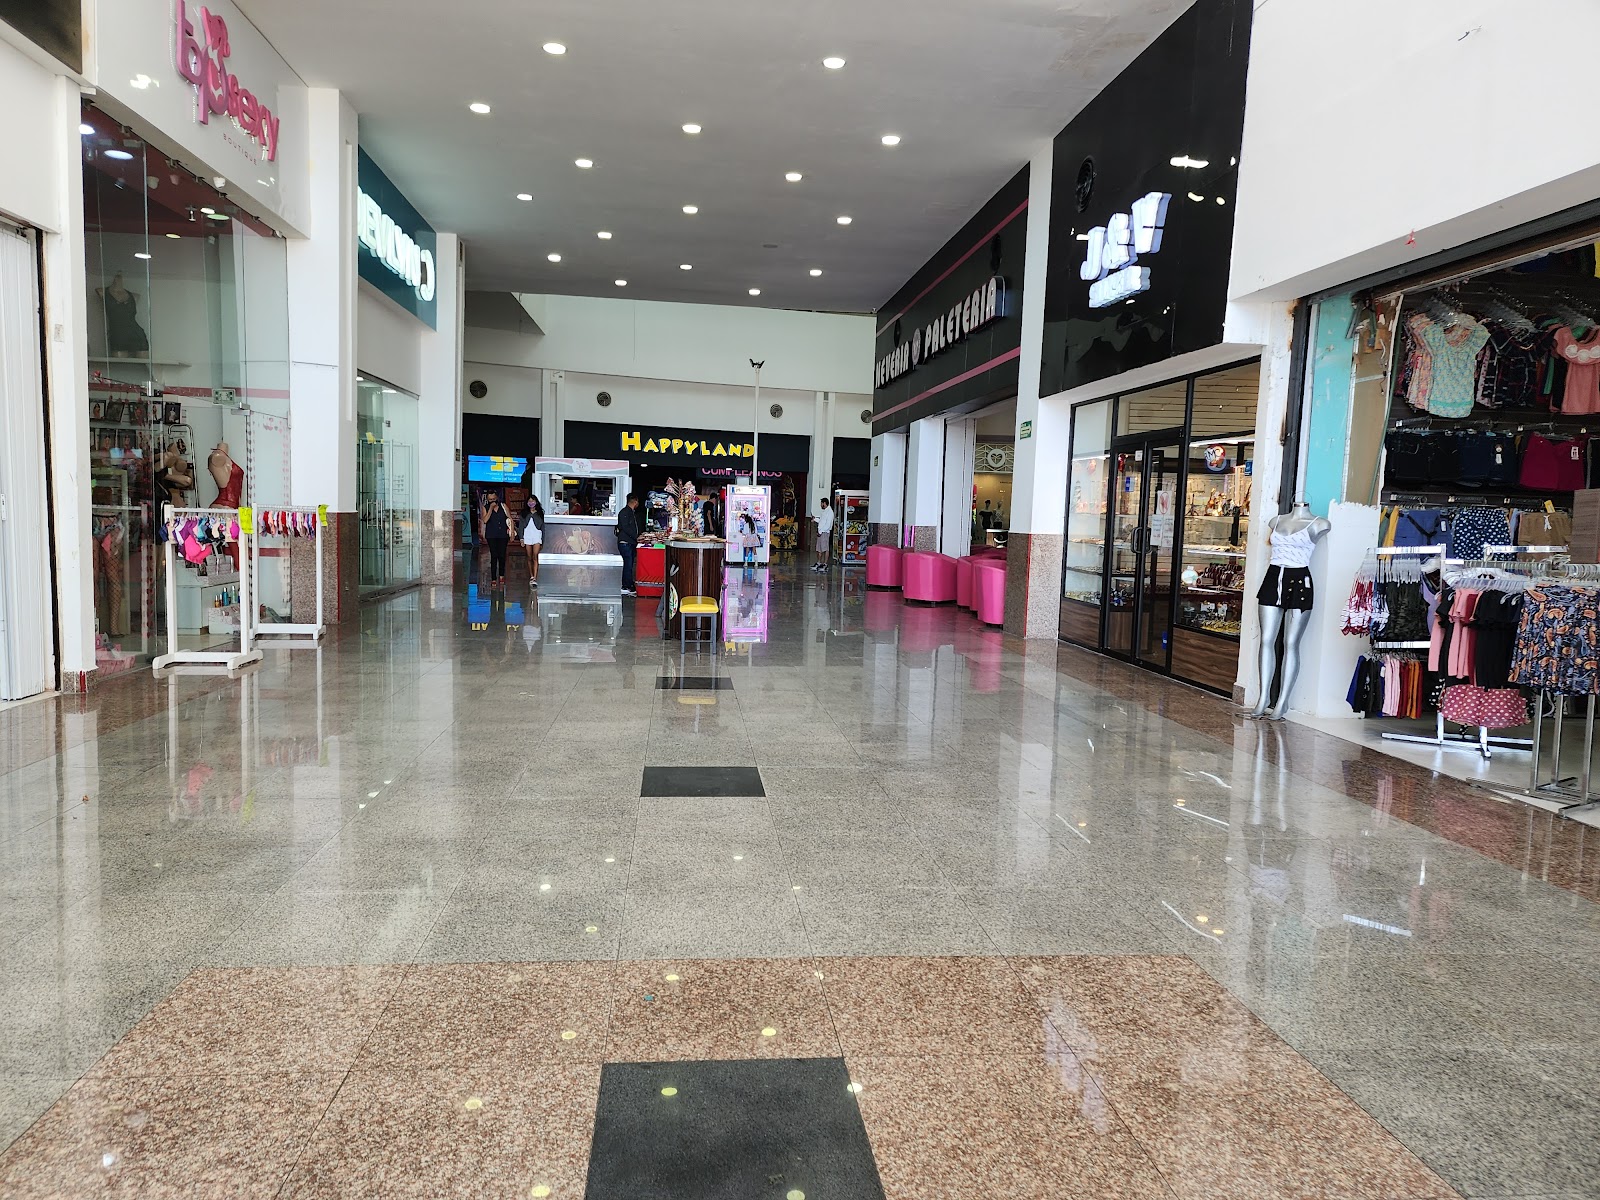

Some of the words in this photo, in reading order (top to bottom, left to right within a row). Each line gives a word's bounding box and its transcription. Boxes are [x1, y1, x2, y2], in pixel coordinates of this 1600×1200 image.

[223, 133, 258, 166] BOUTIQUE
[875, 341, 910, 389] NEVERIA
[924, 277, 999, 359] PALETERIA
[620, 431, 755, 458] HAPPYLAND
